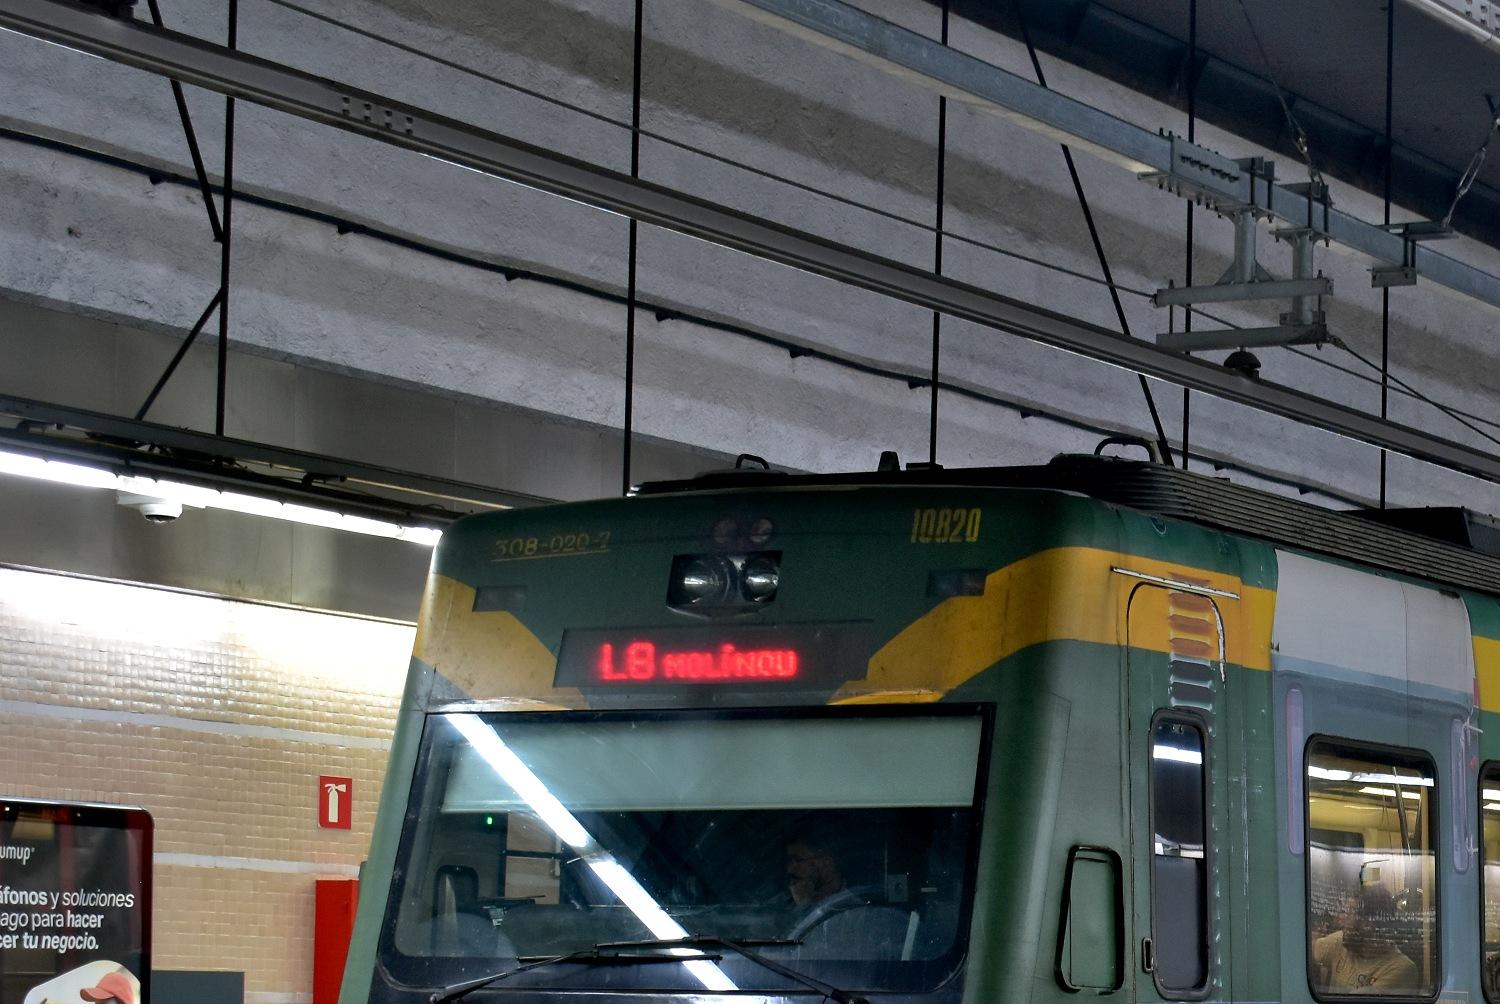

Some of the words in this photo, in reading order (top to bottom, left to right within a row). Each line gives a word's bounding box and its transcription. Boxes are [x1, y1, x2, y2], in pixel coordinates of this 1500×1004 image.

[911, 508, 982, 544] 10820
[50, 891, 60, 910] y
[62, 888, 135, 908] soluciones
[31, 912, 64, 931] para
[67, 910, 104, 928] hacer
[22, 932, 38, 949] tu
[41, 931, 99, 954] negocio.
